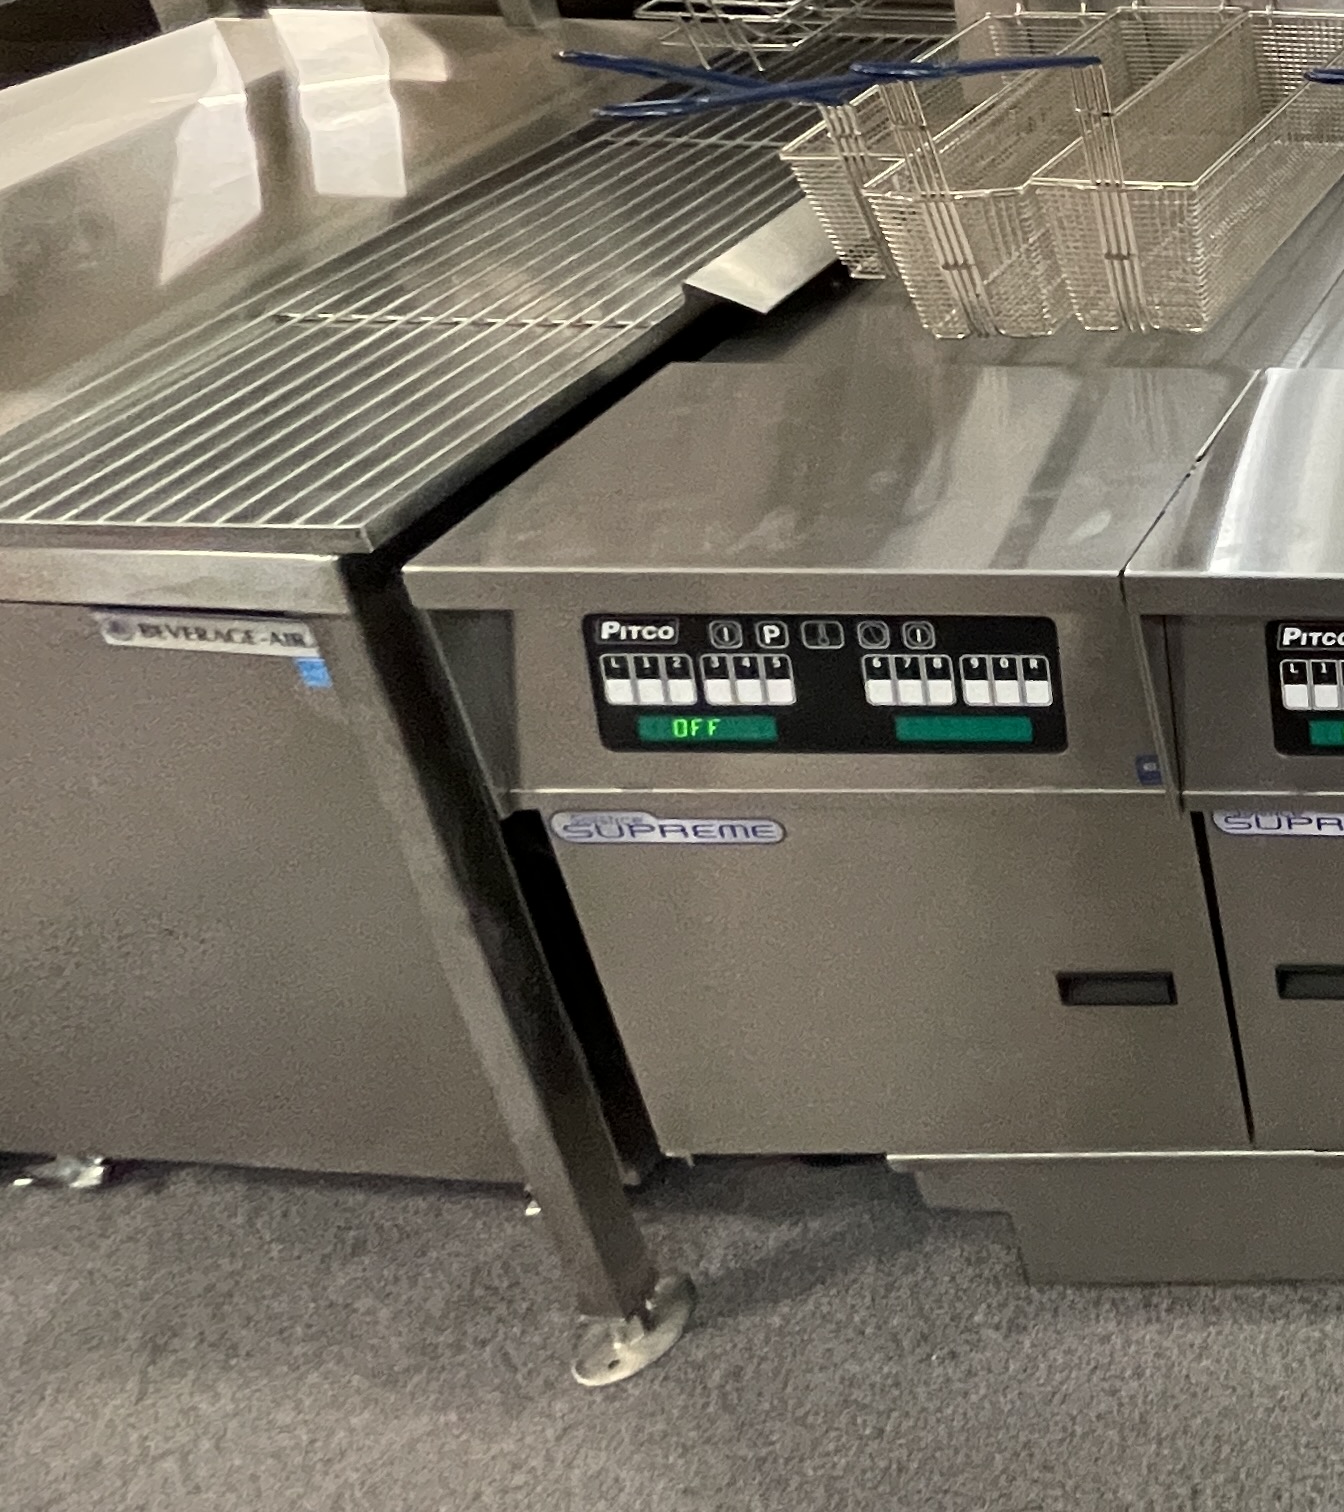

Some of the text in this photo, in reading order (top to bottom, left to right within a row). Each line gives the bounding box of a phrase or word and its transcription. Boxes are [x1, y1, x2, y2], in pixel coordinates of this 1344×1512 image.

[762, 624, 781, 644] P
[672, 718, 721, 738] OFF
[563, 823, 776, 839] SUPREME
